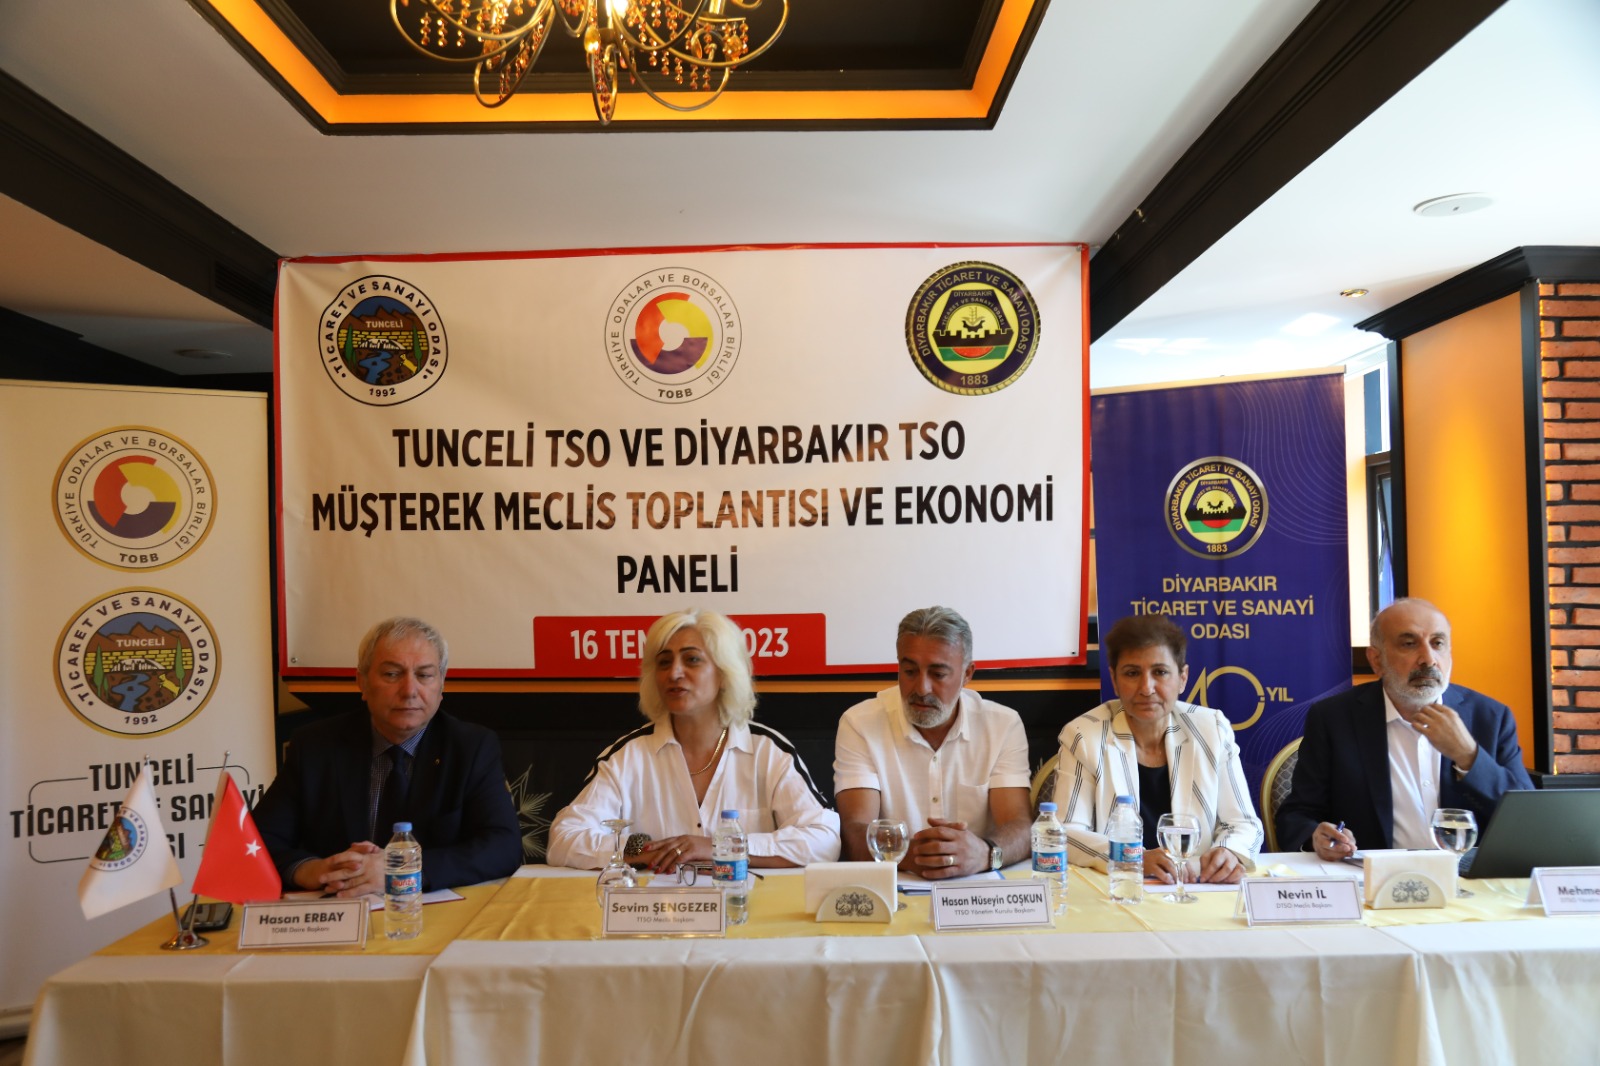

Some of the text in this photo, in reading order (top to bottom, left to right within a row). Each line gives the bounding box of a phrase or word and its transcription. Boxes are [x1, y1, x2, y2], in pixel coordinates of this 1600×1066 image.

[916, 271, 1031, 357] DİYARBAKIR TİCARET VE SANAYİ ODASI
[325, 281, 441, 375] TİCARET VE SANAYİ ODASI
[366, 320, 403, 328] TUNCELİ
[611, 273, 736, 386] TÜRKİYE ODALAR VE BORSALAR BİRLİĞİ
[960, 374, 988, 385] 1883
[369, 387, 396, 397] 1992
[658, 388, 693, 399] TOBB
[392, 418, 966, 468] TUNCELİ TSO VE DİYARBAKIR TSO
[65, 436, 206, 550] TÜRKİYE ODALAR VE BORSALAR BİRLİĞİ
[1171, 480, 1188, 531] DİYARBAKIR
[1186, 464, 1221, 481] TİCARET
[1223, 465, 1236, 475] VE
[1235, 472, 1260, 499] SANAYİ
[1249, 500, 1260, 528] ODASI
[312, 474, 1053, 538] MÜŞTEREK MECLİS TOPLANTISI VE EKONOMİ
[1206, 544, 1228, 553] 1883
[119, 553, 159, 563] TOBB
[617, 545, 738, 594] PANELİ
[1162, 574, 1277, 593] DİYARBAKIR
[1130, 595, 1314, 616] TİCARET VE SANAYİ
[1190, 623, 1250, 639] ODASI
[67, 596, 209, 702] TİCARET VE SANAYİ ODASI
[115, 636, 165, 647] TUNCELİ
[570, 629, 599, 660] 16
[741, 627, 789, 658] 023
[1266, 687, 1294, 702] YIL
[124, 714, 158, 725] 1992
[941, 893, 1043, 907] Hasan Hüseyin COŞKUN
[1277, 886, 1327, 900] Nevin İL
[611, 902, 718, 915] Sevim ŞENGEZER
[259, 912, 345, 925] Hasan ERBAY
